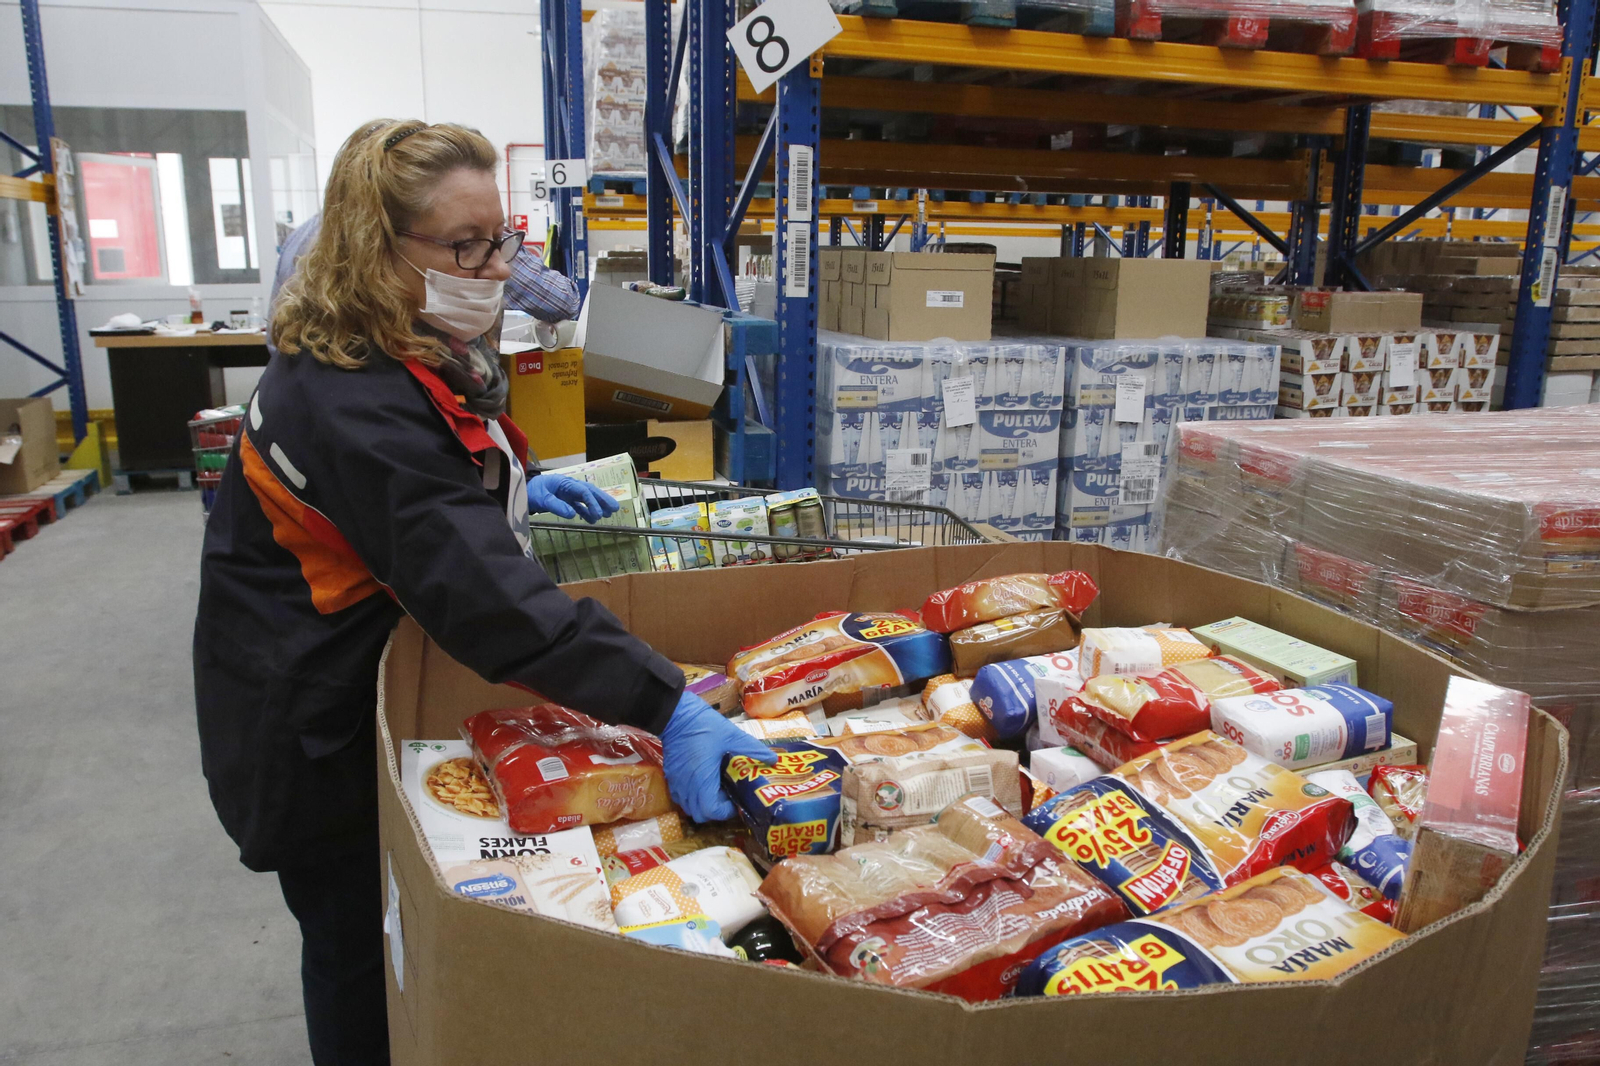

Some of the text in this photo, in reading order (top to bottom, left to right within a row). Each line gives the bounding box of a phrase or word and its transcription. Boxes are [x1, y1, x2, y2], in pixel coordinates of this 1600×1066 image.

[746, 15, 790, 73] 8
[552, 162, 567, 185] 6
[534, 181, 547, 199] 5
[860, 375, 899, 385] ENTERA
[1102, 374, 1118, 384] ENT
[992, 413, 1052, 427] PULEVA
[1217, 406, 1269, 419] PULEVA
[1002, 439, 1038, 448] ENTERA
[846, 478, 885, 491] PUL
[1094, 497, 1119, 506] ENTE
[1554, 512, 1584, 530] apis
[1320, 567, 1341, 583] apis
[1425, 602, 1450, 620] apis
[787, 685, 824, 707] MARÍA
[1223, 721, 1245, 746] SOS
[1283, 741, 1293, 761] SOS
[1475, 722, 1500, 797] CAMPURRIANAS
[761, 772, 835, 799] OFERTÓN
[557, 815, 582, 824] aliada
[1261, 810, 1300, 841] Cuétara
[769, 823, 825, 842] GRATIS
[479, 836, 548, 848] FLAKES
[770, 838, 813, 856] 25%
[1076, 818, 1149, 866] 25%
[570, 857, 582, 866] 6
[1128, 846, 1187, 904] OFERTÓN
[460, 879, 509, 894] Nestlé
[1245, 919, 1334, 965] ORO
[1269, 936, 1356, 974] MARÍA
[1057, 941, 1168, 995] GRATIS
